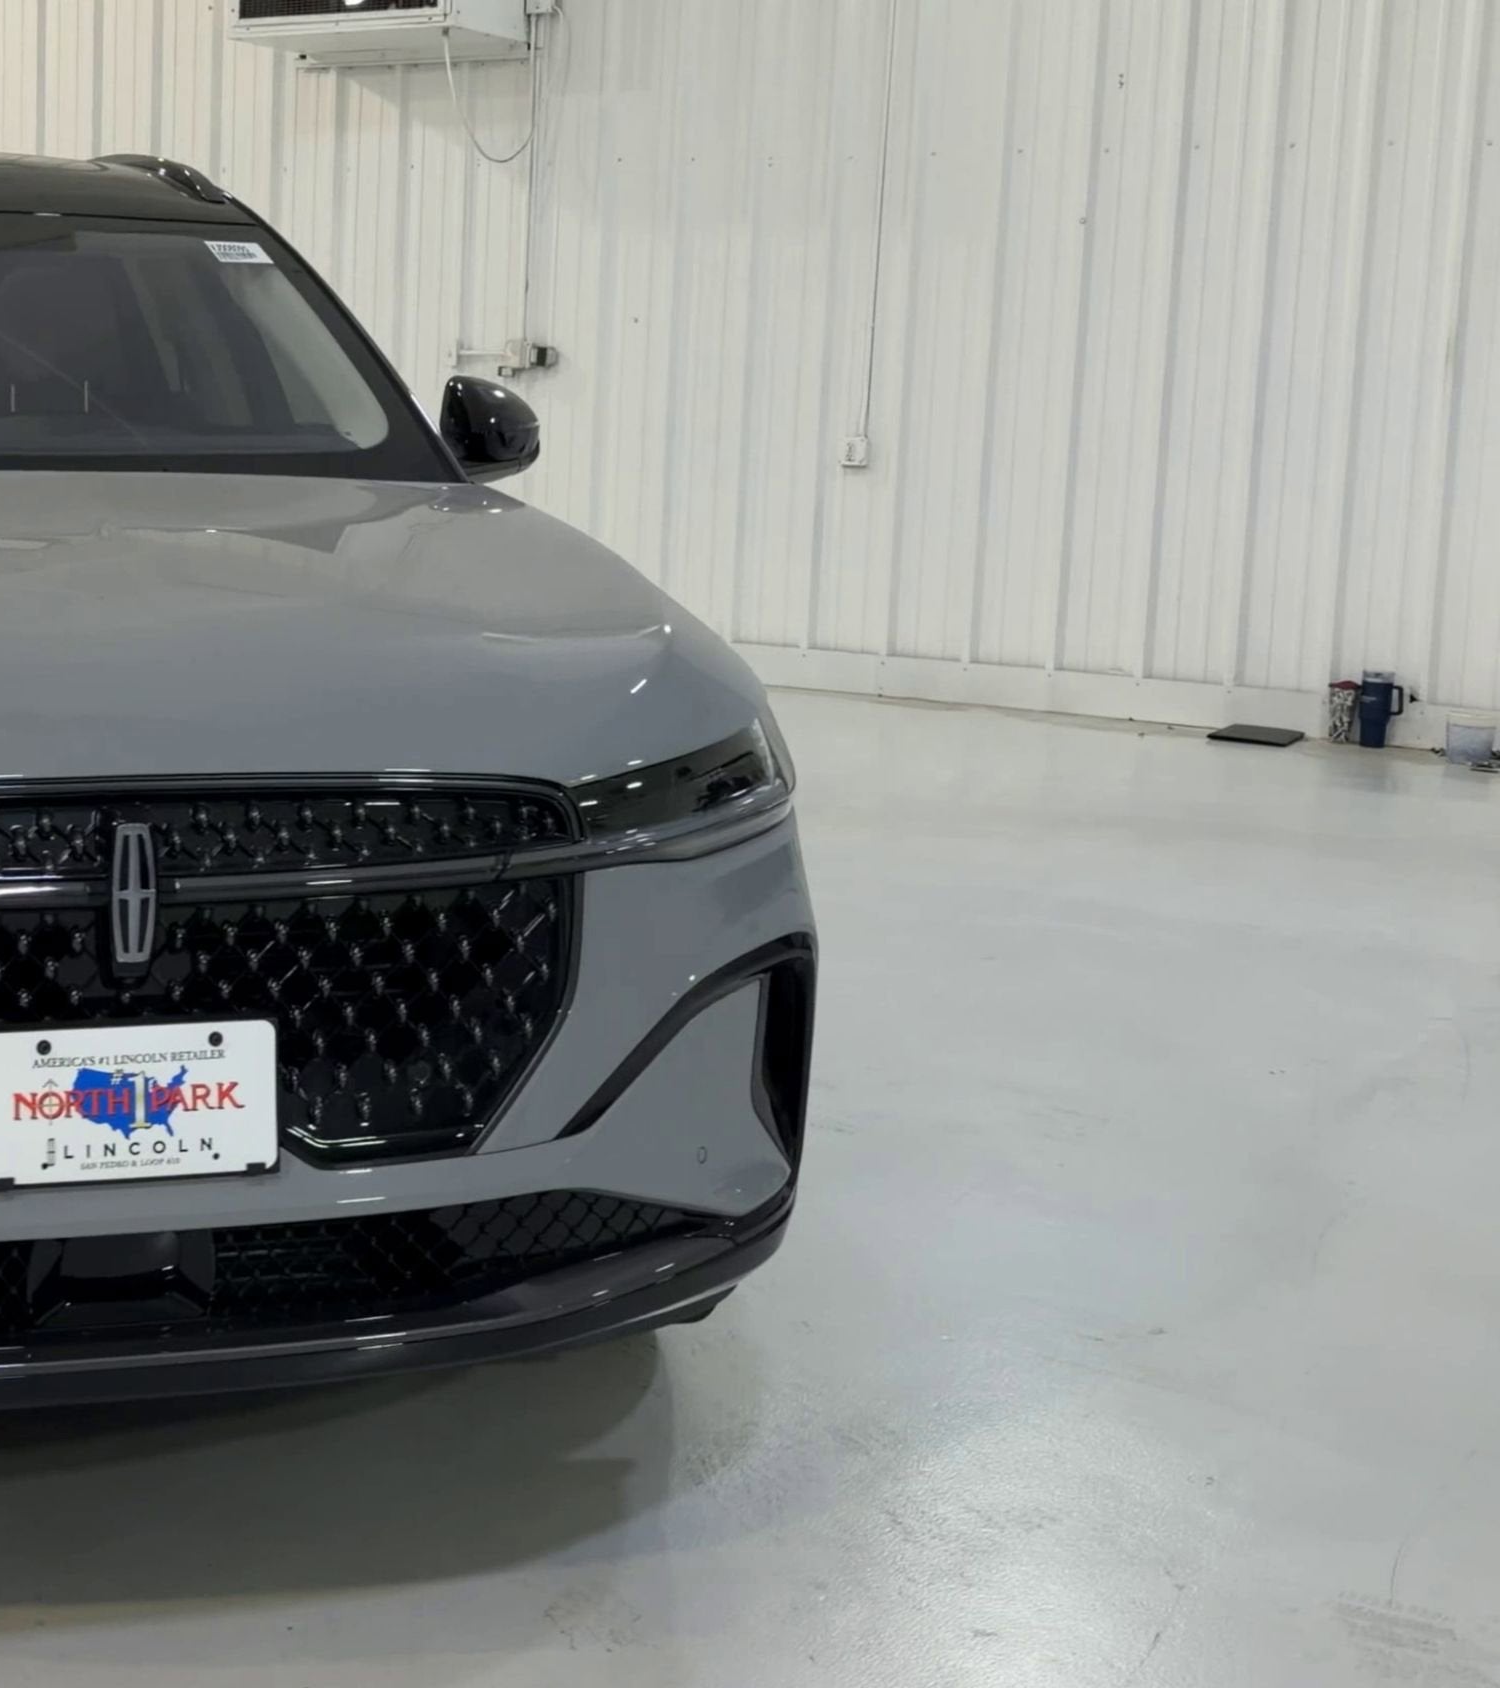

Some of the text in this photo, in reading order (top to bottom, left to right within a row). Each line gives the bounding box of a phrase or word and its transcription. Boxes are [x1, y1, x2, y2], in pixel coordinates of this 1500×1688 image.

[32, 1049, 226, 1069] AMERICA'S #1 LINCOLN RETAILER
[12, 1081, 246, 1121] NORTH PARK
[63, 1137, 213, 1160] LINCOLN
